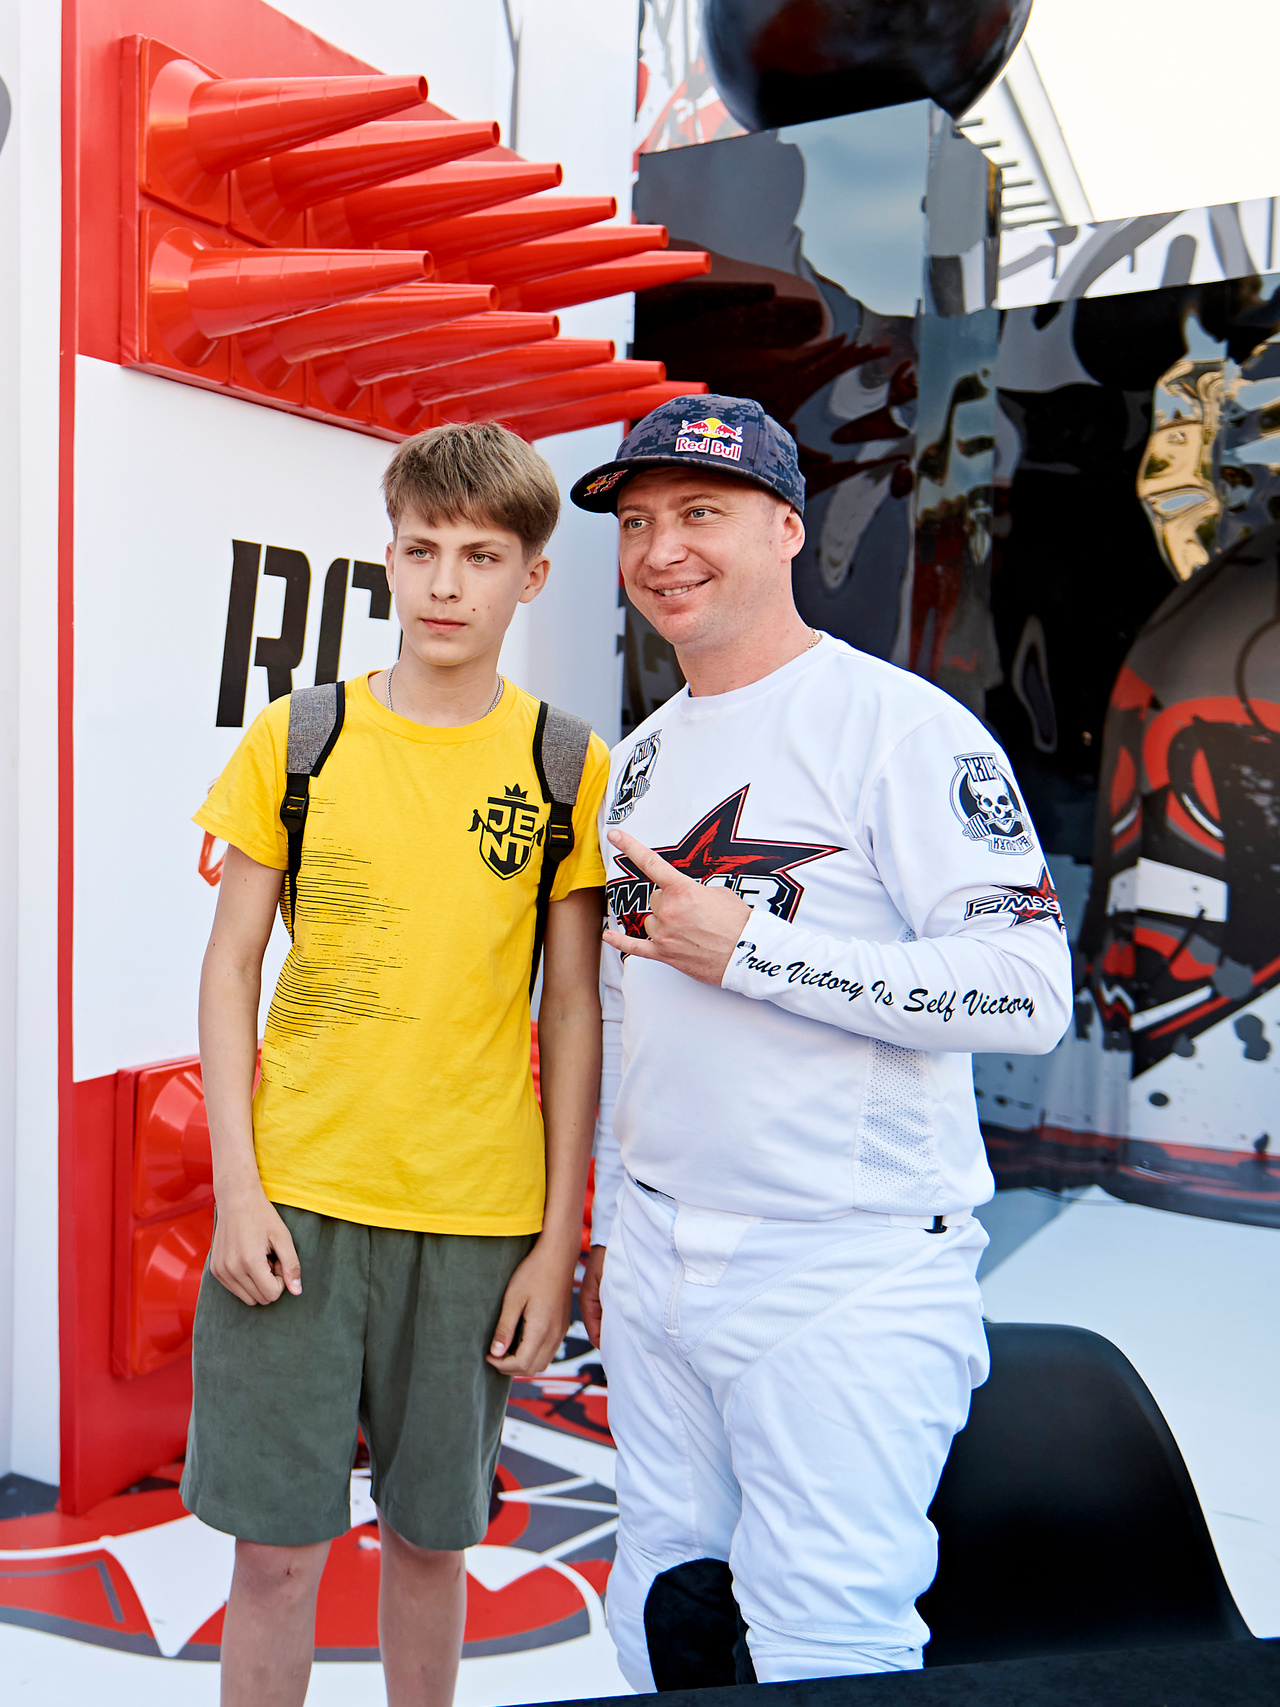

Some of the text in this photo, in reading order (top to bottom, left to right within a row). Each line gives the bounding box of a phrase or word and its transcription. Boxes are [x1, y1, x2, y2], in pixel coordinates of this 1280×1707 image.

[676, 437, 742, 461] Red Bull
[216, 538, 403, 727] RC
[736, 940, 1035, 1023] True Victory Is Self Victory
